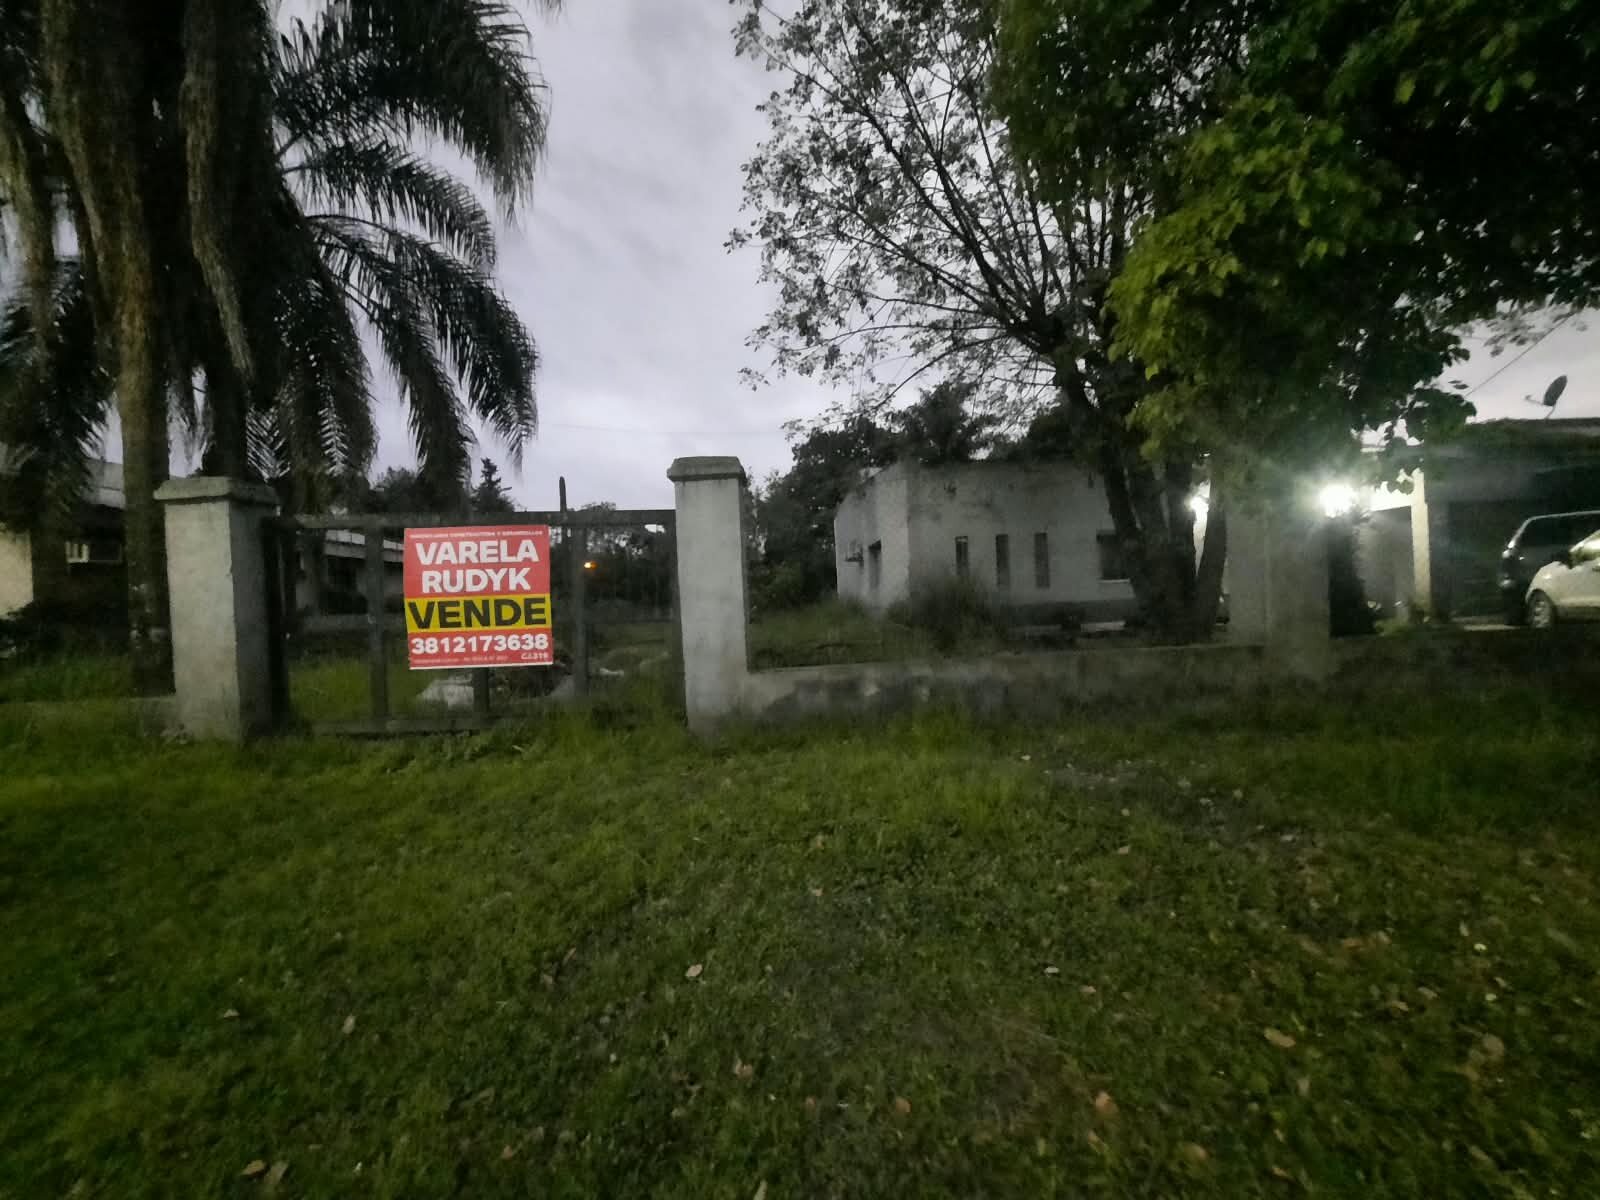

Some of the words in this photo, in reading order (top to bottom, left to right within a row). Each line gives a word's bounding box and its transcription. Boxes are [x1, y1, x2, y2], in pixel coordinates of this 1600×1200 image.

[416, 539, 539, 565] VARELA
[422, 567, 531, 593] RUDYK
[408, 598, 547, 629] VENDE
[411, 633, 549, 655] 3812173638
